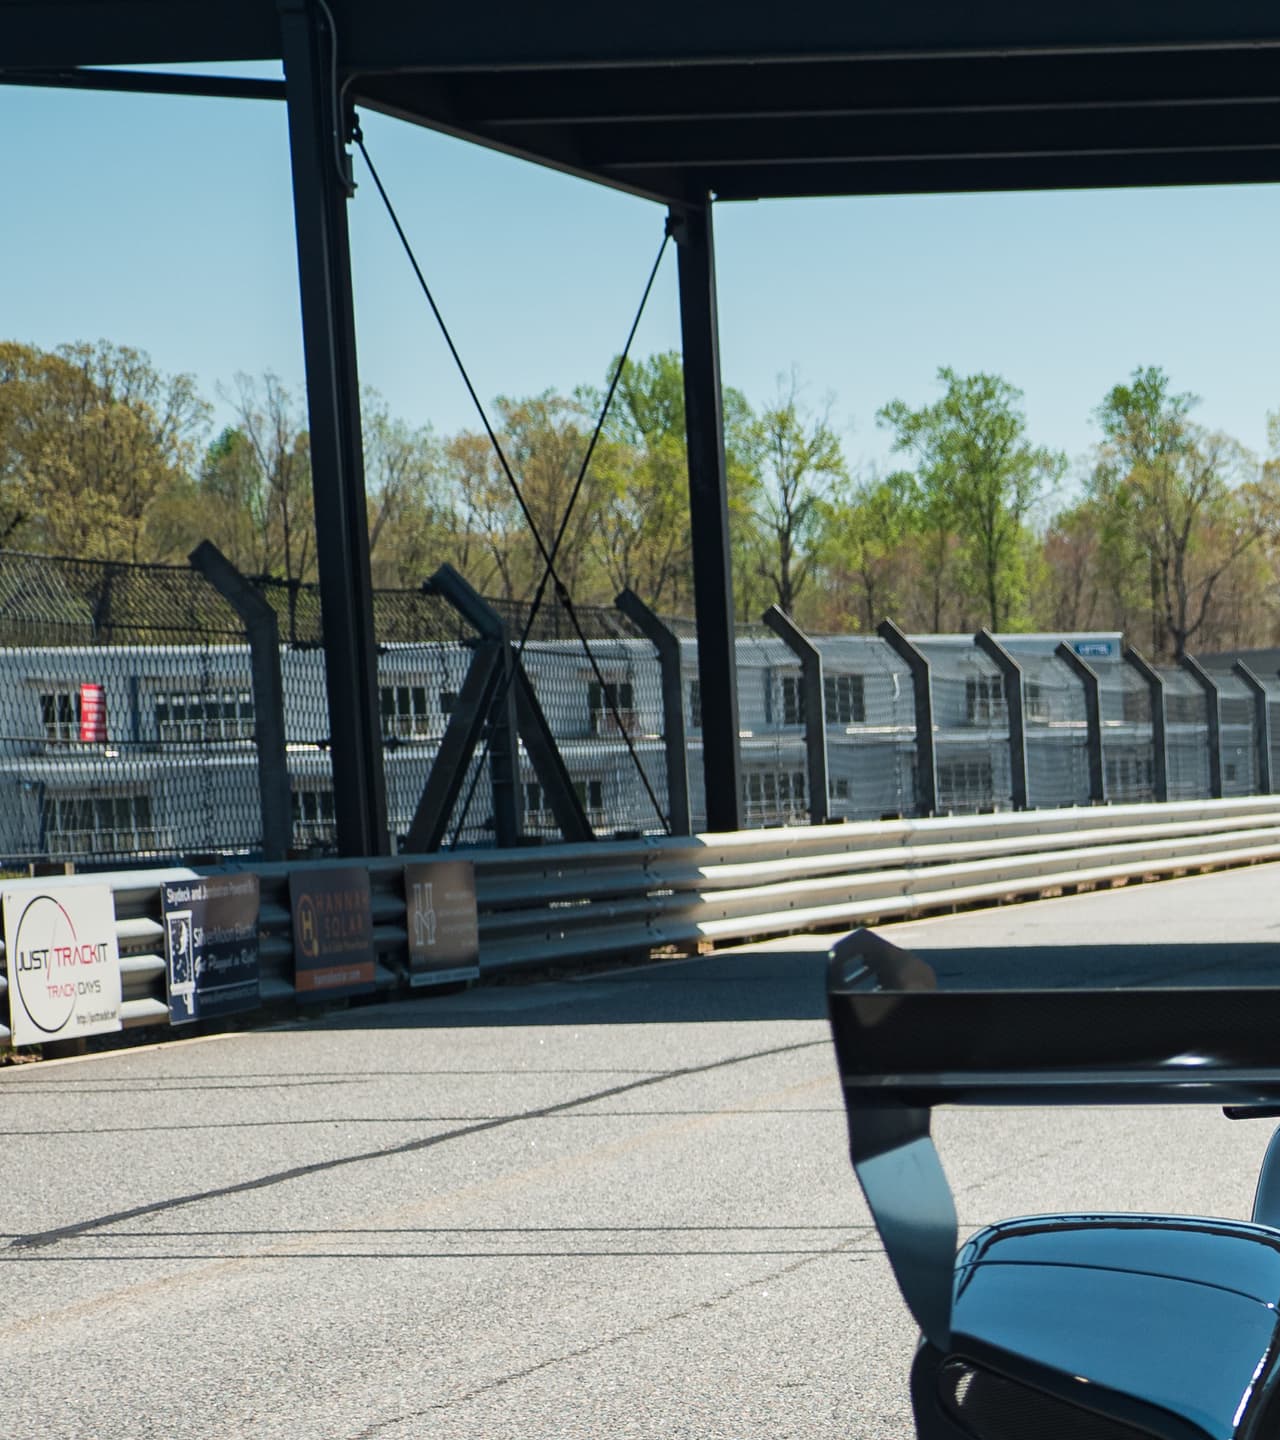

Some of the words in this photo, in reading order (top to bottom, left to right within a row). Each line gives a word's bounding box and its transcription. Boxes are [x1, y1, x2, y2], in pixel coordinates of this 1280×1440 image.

[19, 949, 49, 971] JUST
[54, 943, 108, 967] TRACKIT
[47, 983, 75, 998] TRACK
[78, 980, 101, 995] DAYS
